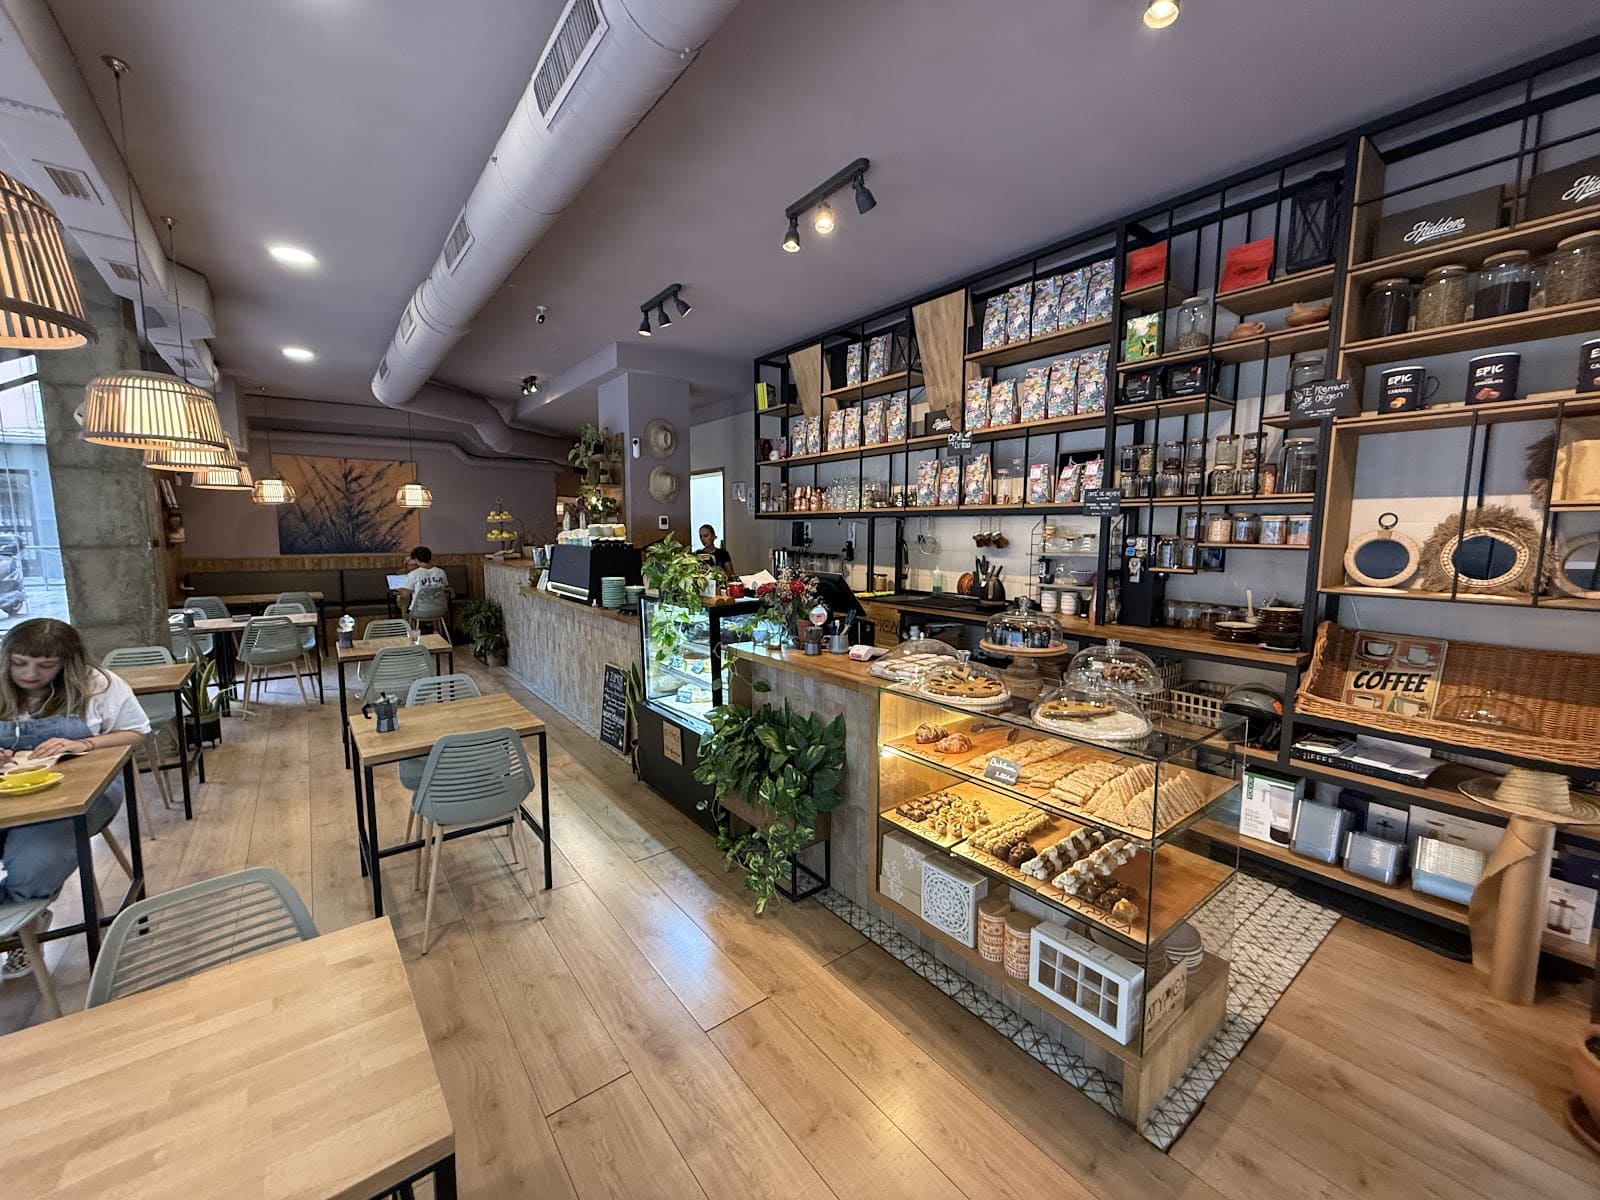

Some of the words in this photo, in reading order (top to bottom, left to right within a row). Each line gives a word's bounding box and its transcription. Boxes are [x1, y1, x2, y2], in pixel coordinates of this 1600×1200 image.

[1403, 216, 1466, 245] Hidden
[1387, 373, 1413, 386] EPIC
[1475, 363, 1504, 377] EPIC
[1387, 387, 1413, 395] CARAMEL
[1353, 670, 1432, 693] COFFEE
[965, 850, 1028, 882] ATYPICA
[1050, 892, 1131, 935] ATYPICA
[1145, 973, 1187, 1025] ATYPICA
